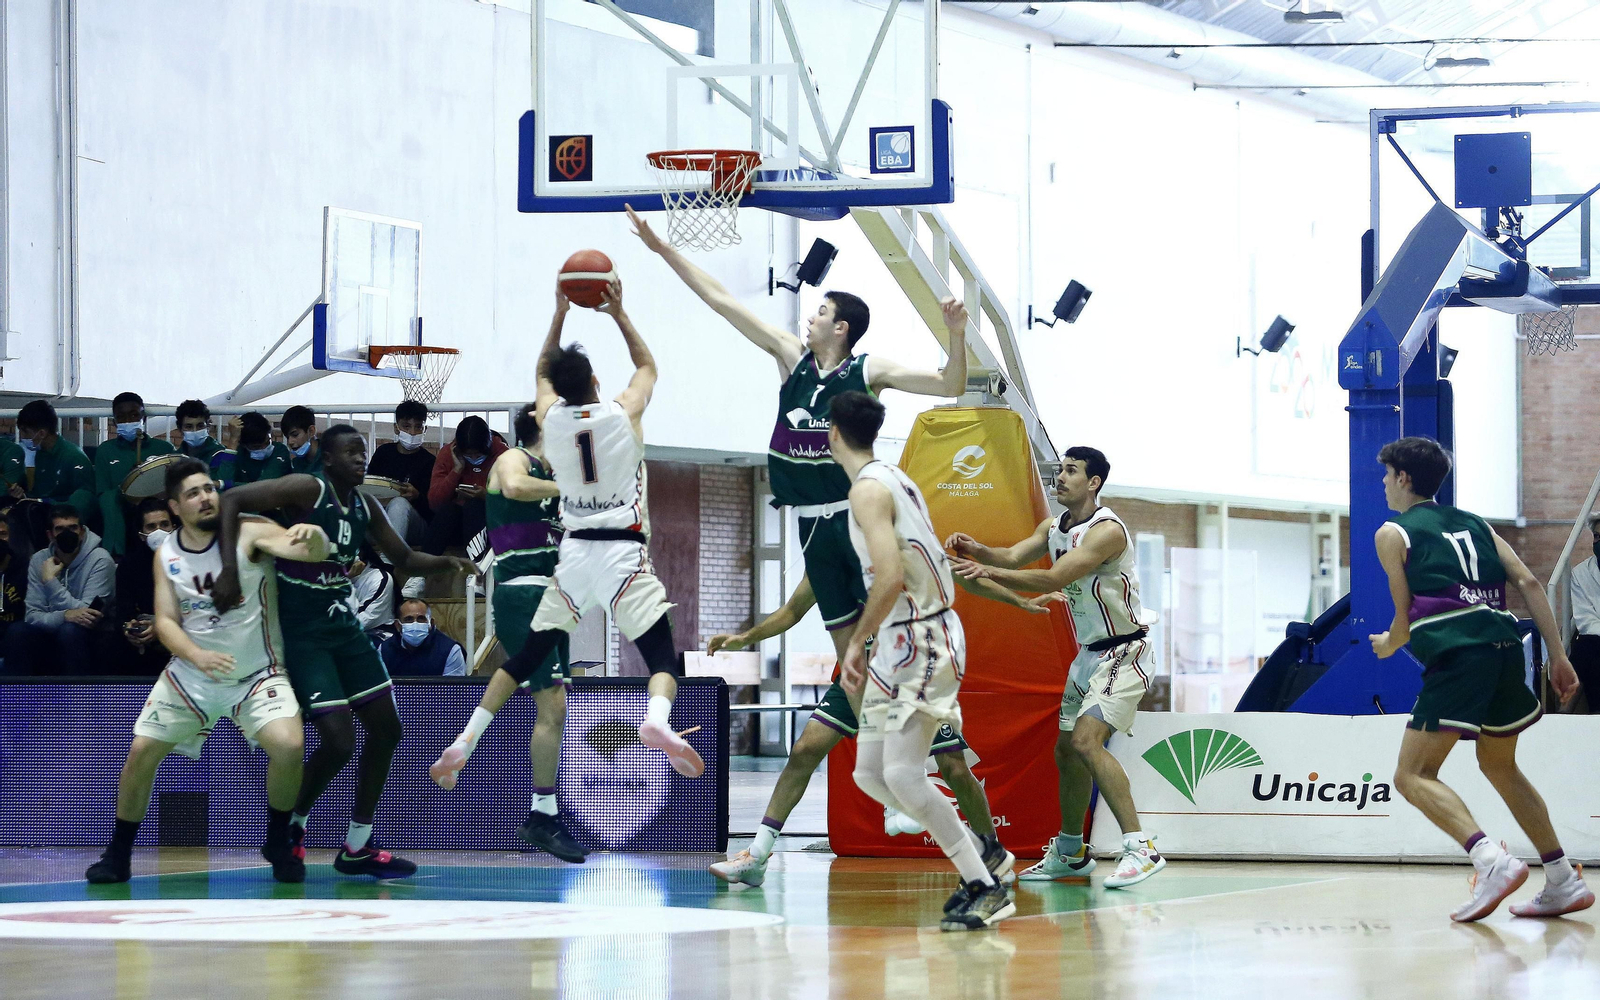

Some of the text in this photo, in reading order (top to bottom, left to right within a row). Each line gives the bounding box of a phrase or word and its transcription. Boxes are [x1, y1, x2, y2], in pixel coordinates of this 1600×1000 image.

[881, 155, 903, 166] EBA
[809, 384, 826, 408] 7
[808, 417, 830, 429] Unic
[574, 429, 598, 485] 1
[936, 482, 962, 490] COSTA
[963, 482, 978, 490] DEL
[337, 519, 352, 546] 19
[1442, 530, 1480, 581] 17
[1252, 772, 1392, 811] Unicaja
[991, 815, 1011, 828] OL
